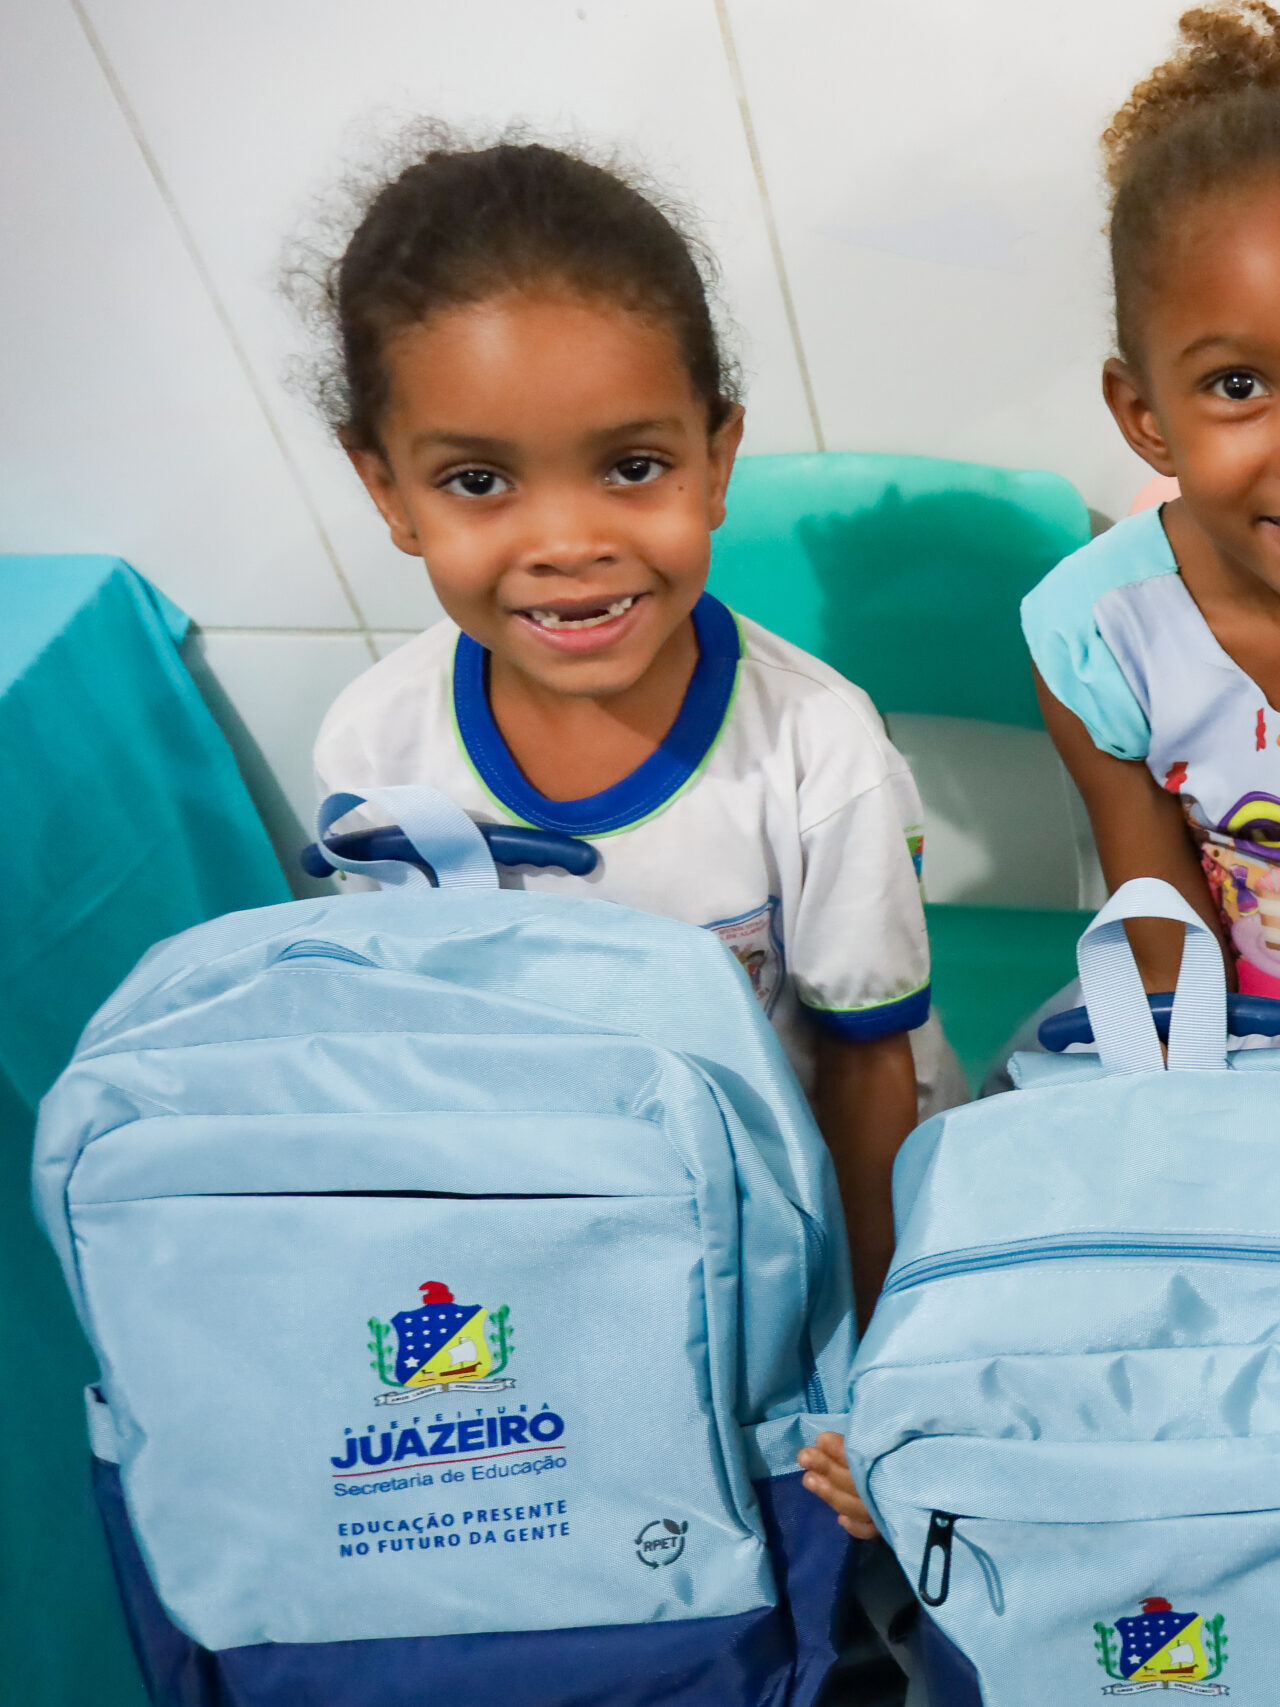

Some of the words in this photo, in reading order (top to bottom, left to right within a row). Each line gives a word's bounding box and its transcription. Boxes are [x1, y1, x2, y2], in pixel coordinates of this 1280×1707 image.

[344, 1402, 550, 1435] PREFEITURA
[331, 1412, 564, 1469] JUAZEIRO
[334, 1472, 433, 1497] Secretaria
[441, 1469, 465, 1484] de
[472, 1455, 567, 1481] Educação
[338, 1512, 455, 1536] EDUCAÇÃO
[463, 1500, 567, 1524] PRESENTE
[340, 1542, 369, 1557] NO
[378, 1533, 461, 1553] FUTURO
[469, 1530, 496, 1545] DA
[504, 1522, 570, 1543] GENTE
[643, 1537, 678, 1552] RPET
